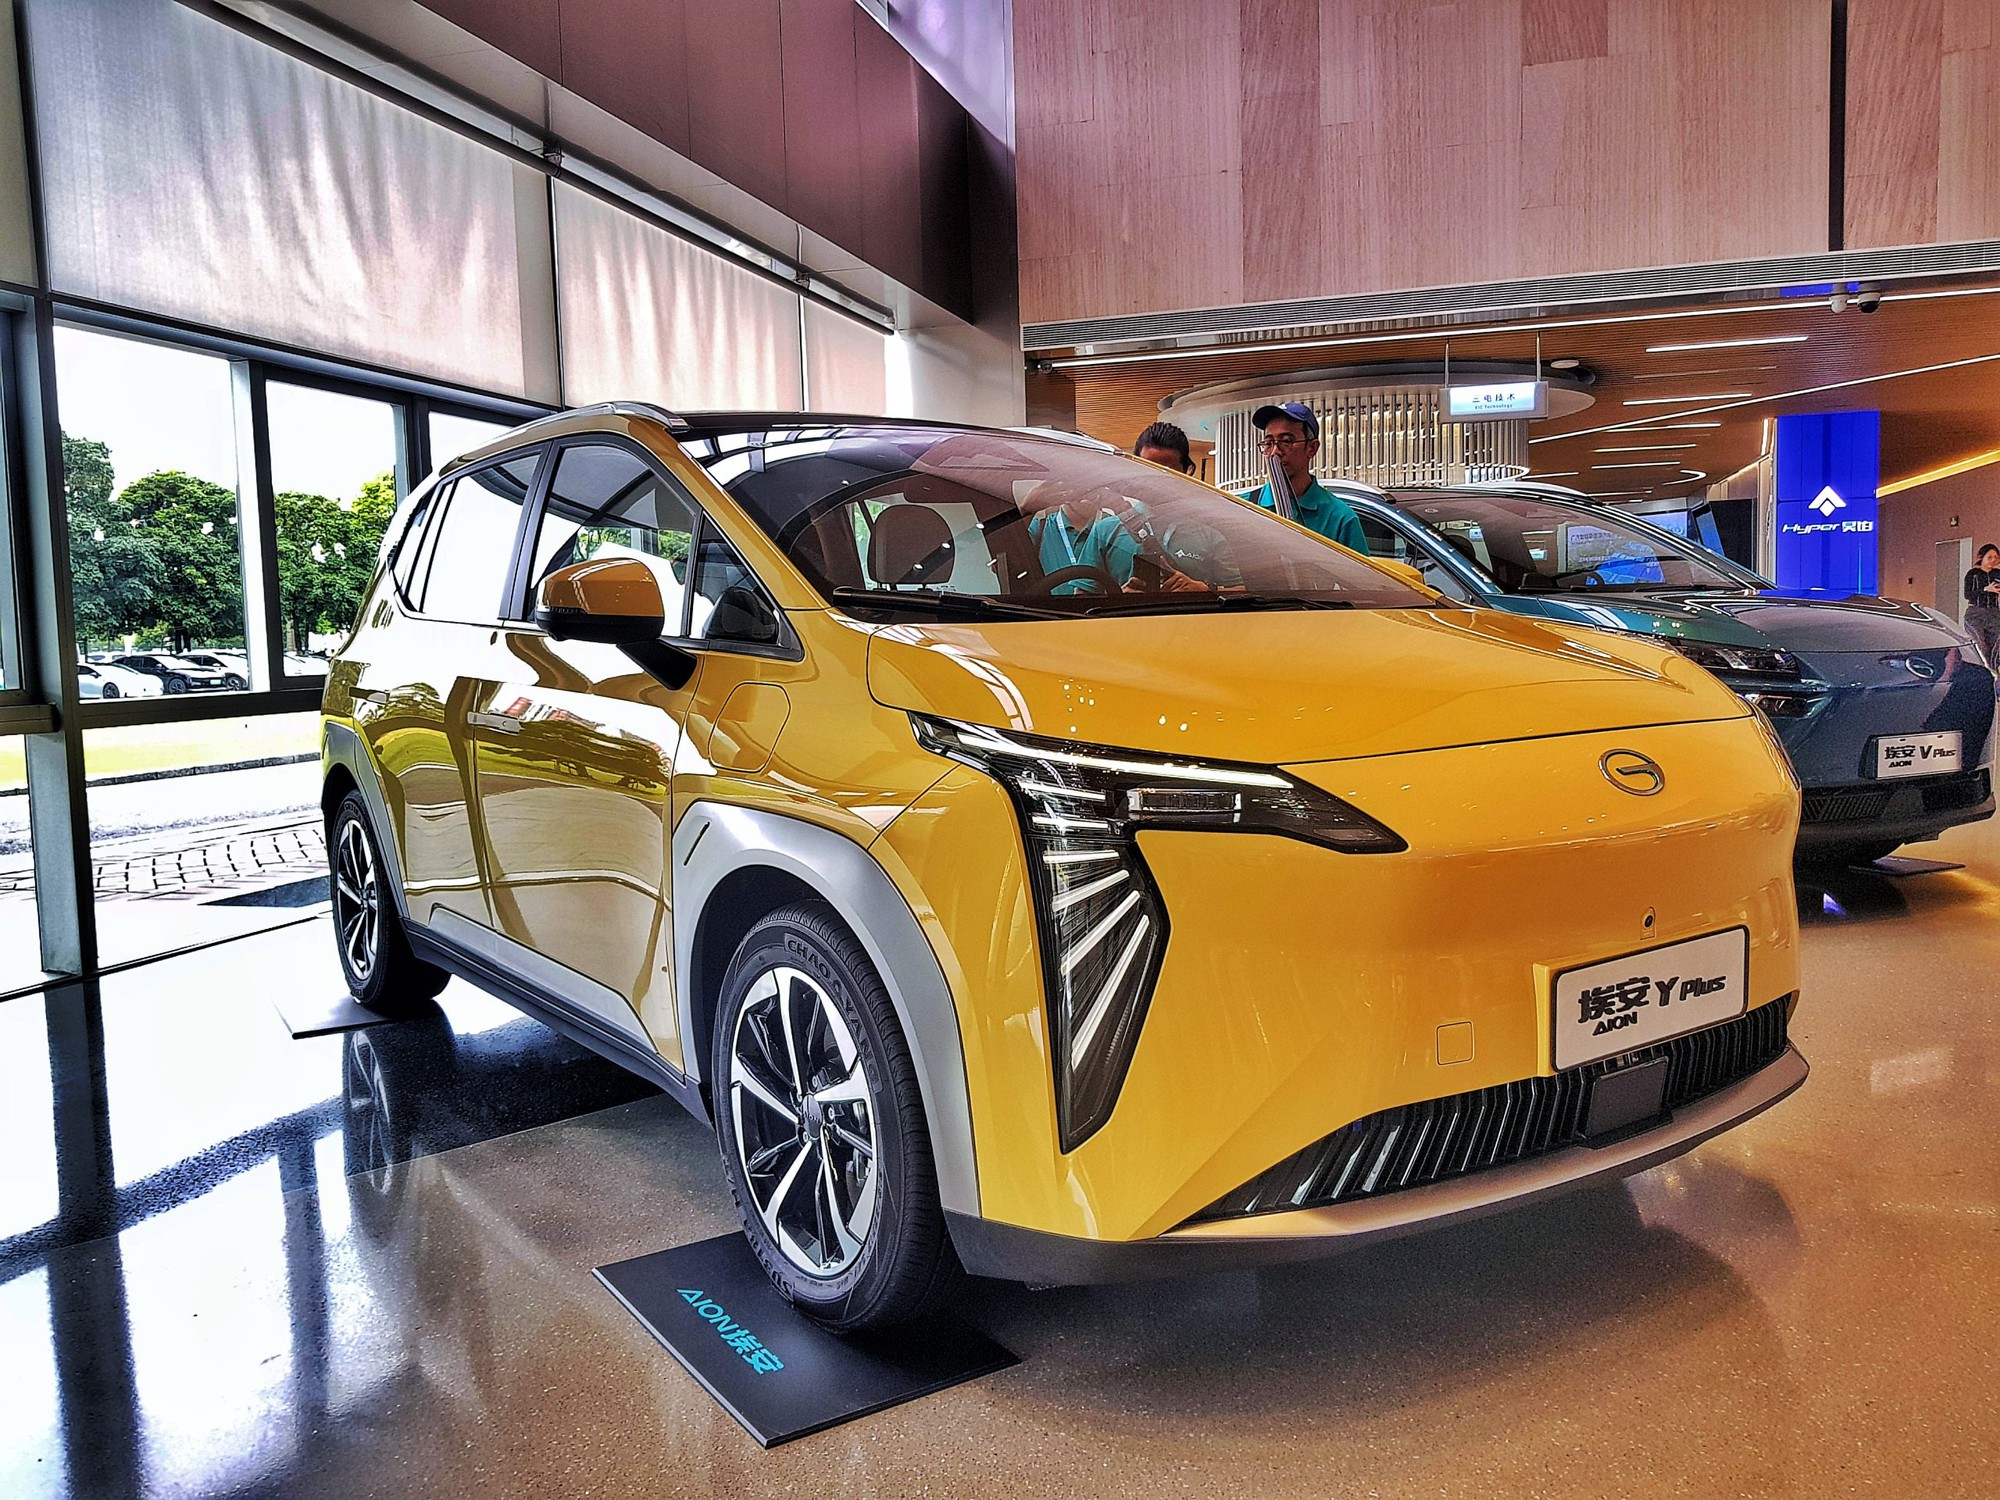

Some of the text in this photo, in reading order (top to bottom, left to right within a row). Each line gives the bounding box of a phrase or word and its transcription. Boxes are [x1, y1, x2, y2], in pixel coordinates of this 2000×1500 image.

[1782, 520, 1874, 535] Hyper 昊铂
[1884, 745, 1957, 760] 埃安 V Plus
[1888, 760, 1912, 768] AION
[1577, 975, 1727, 1024] 埃安 Y Plus
[1592, 1011, 1639, 1036] AION
